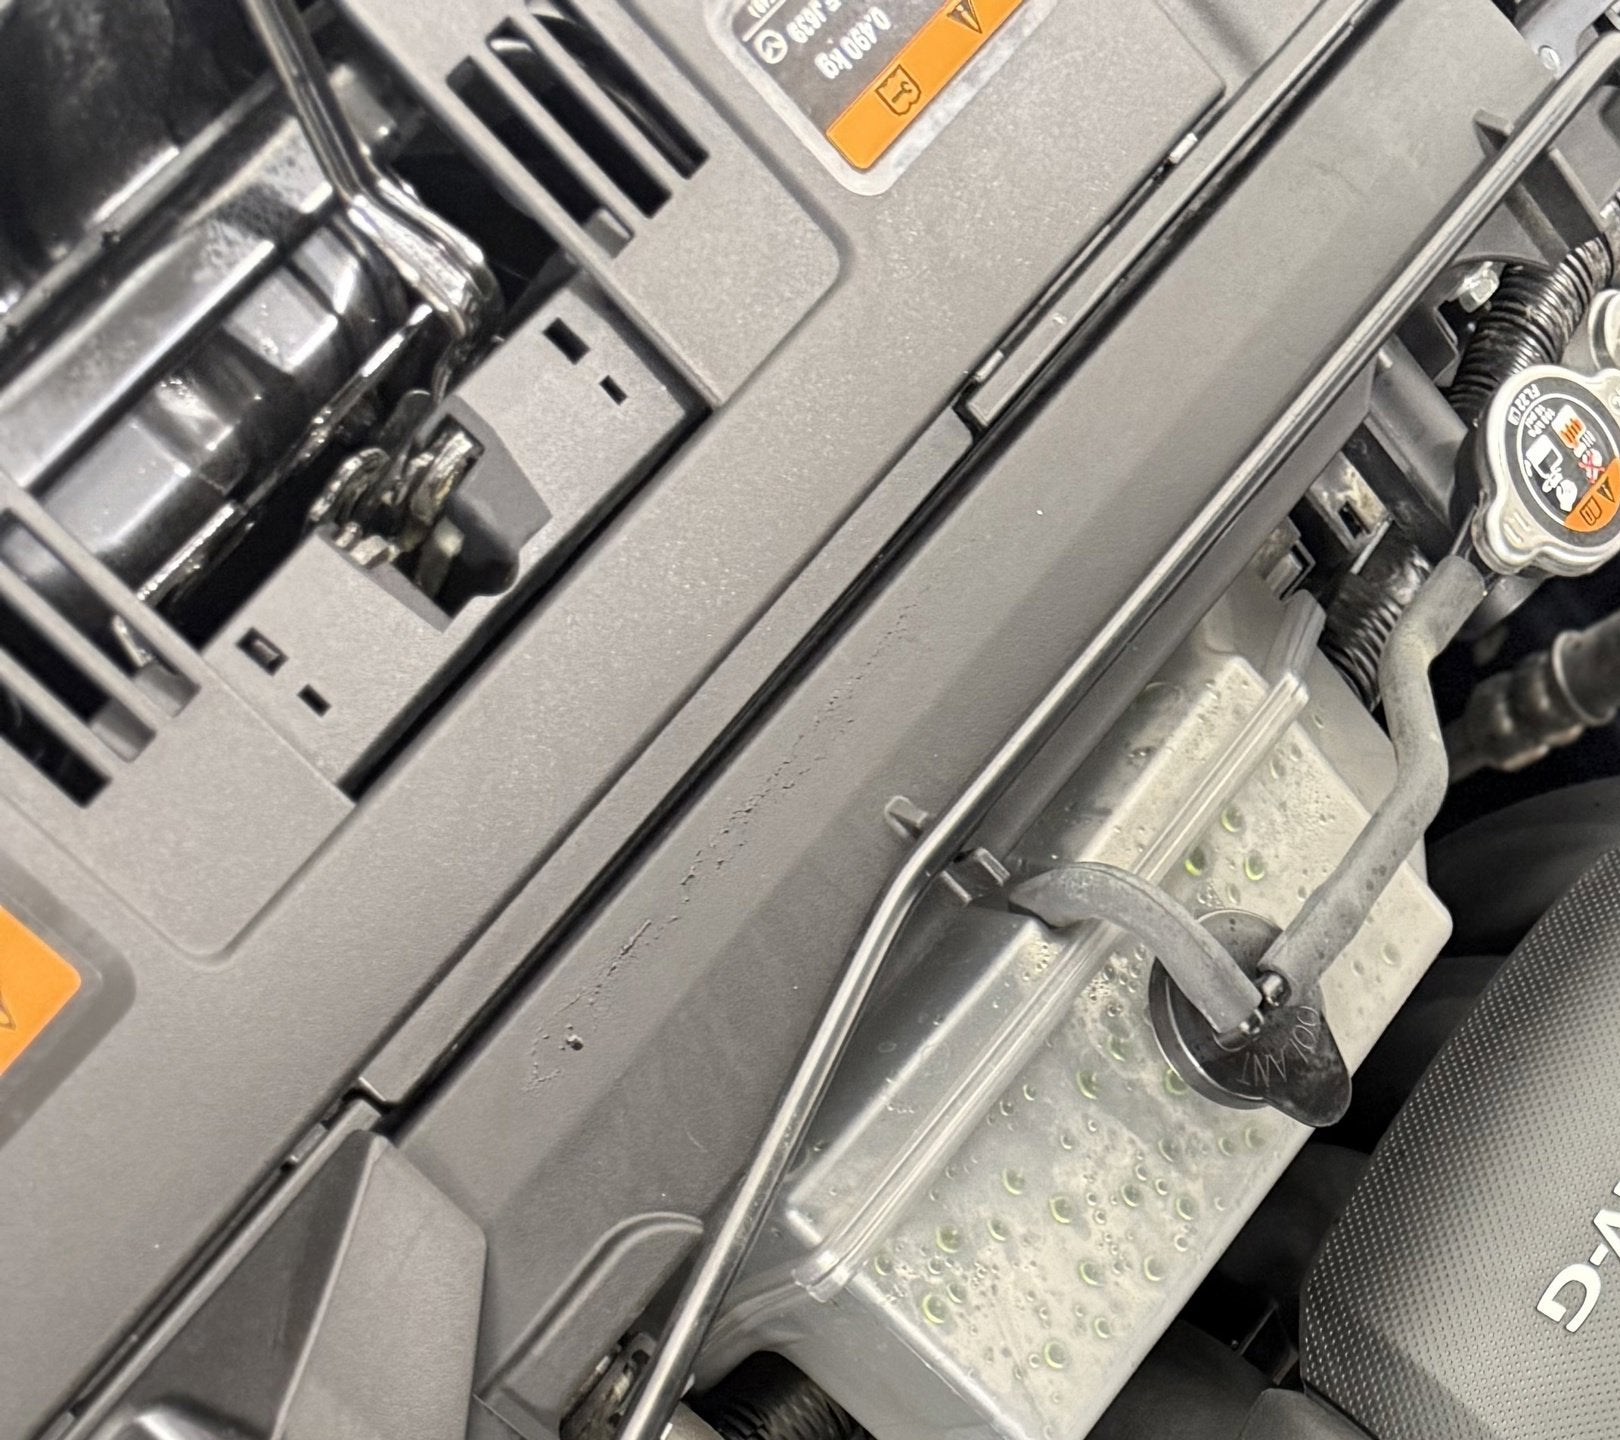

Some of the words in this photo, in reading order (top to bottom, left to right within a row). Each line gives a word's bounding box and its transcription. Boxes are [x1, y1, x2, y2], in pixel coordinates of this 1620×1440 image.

[837, 3, 894, 63] 0.490
[810, 44, 854, 83] kg
[1512, 381, 1542, 413] FL22
